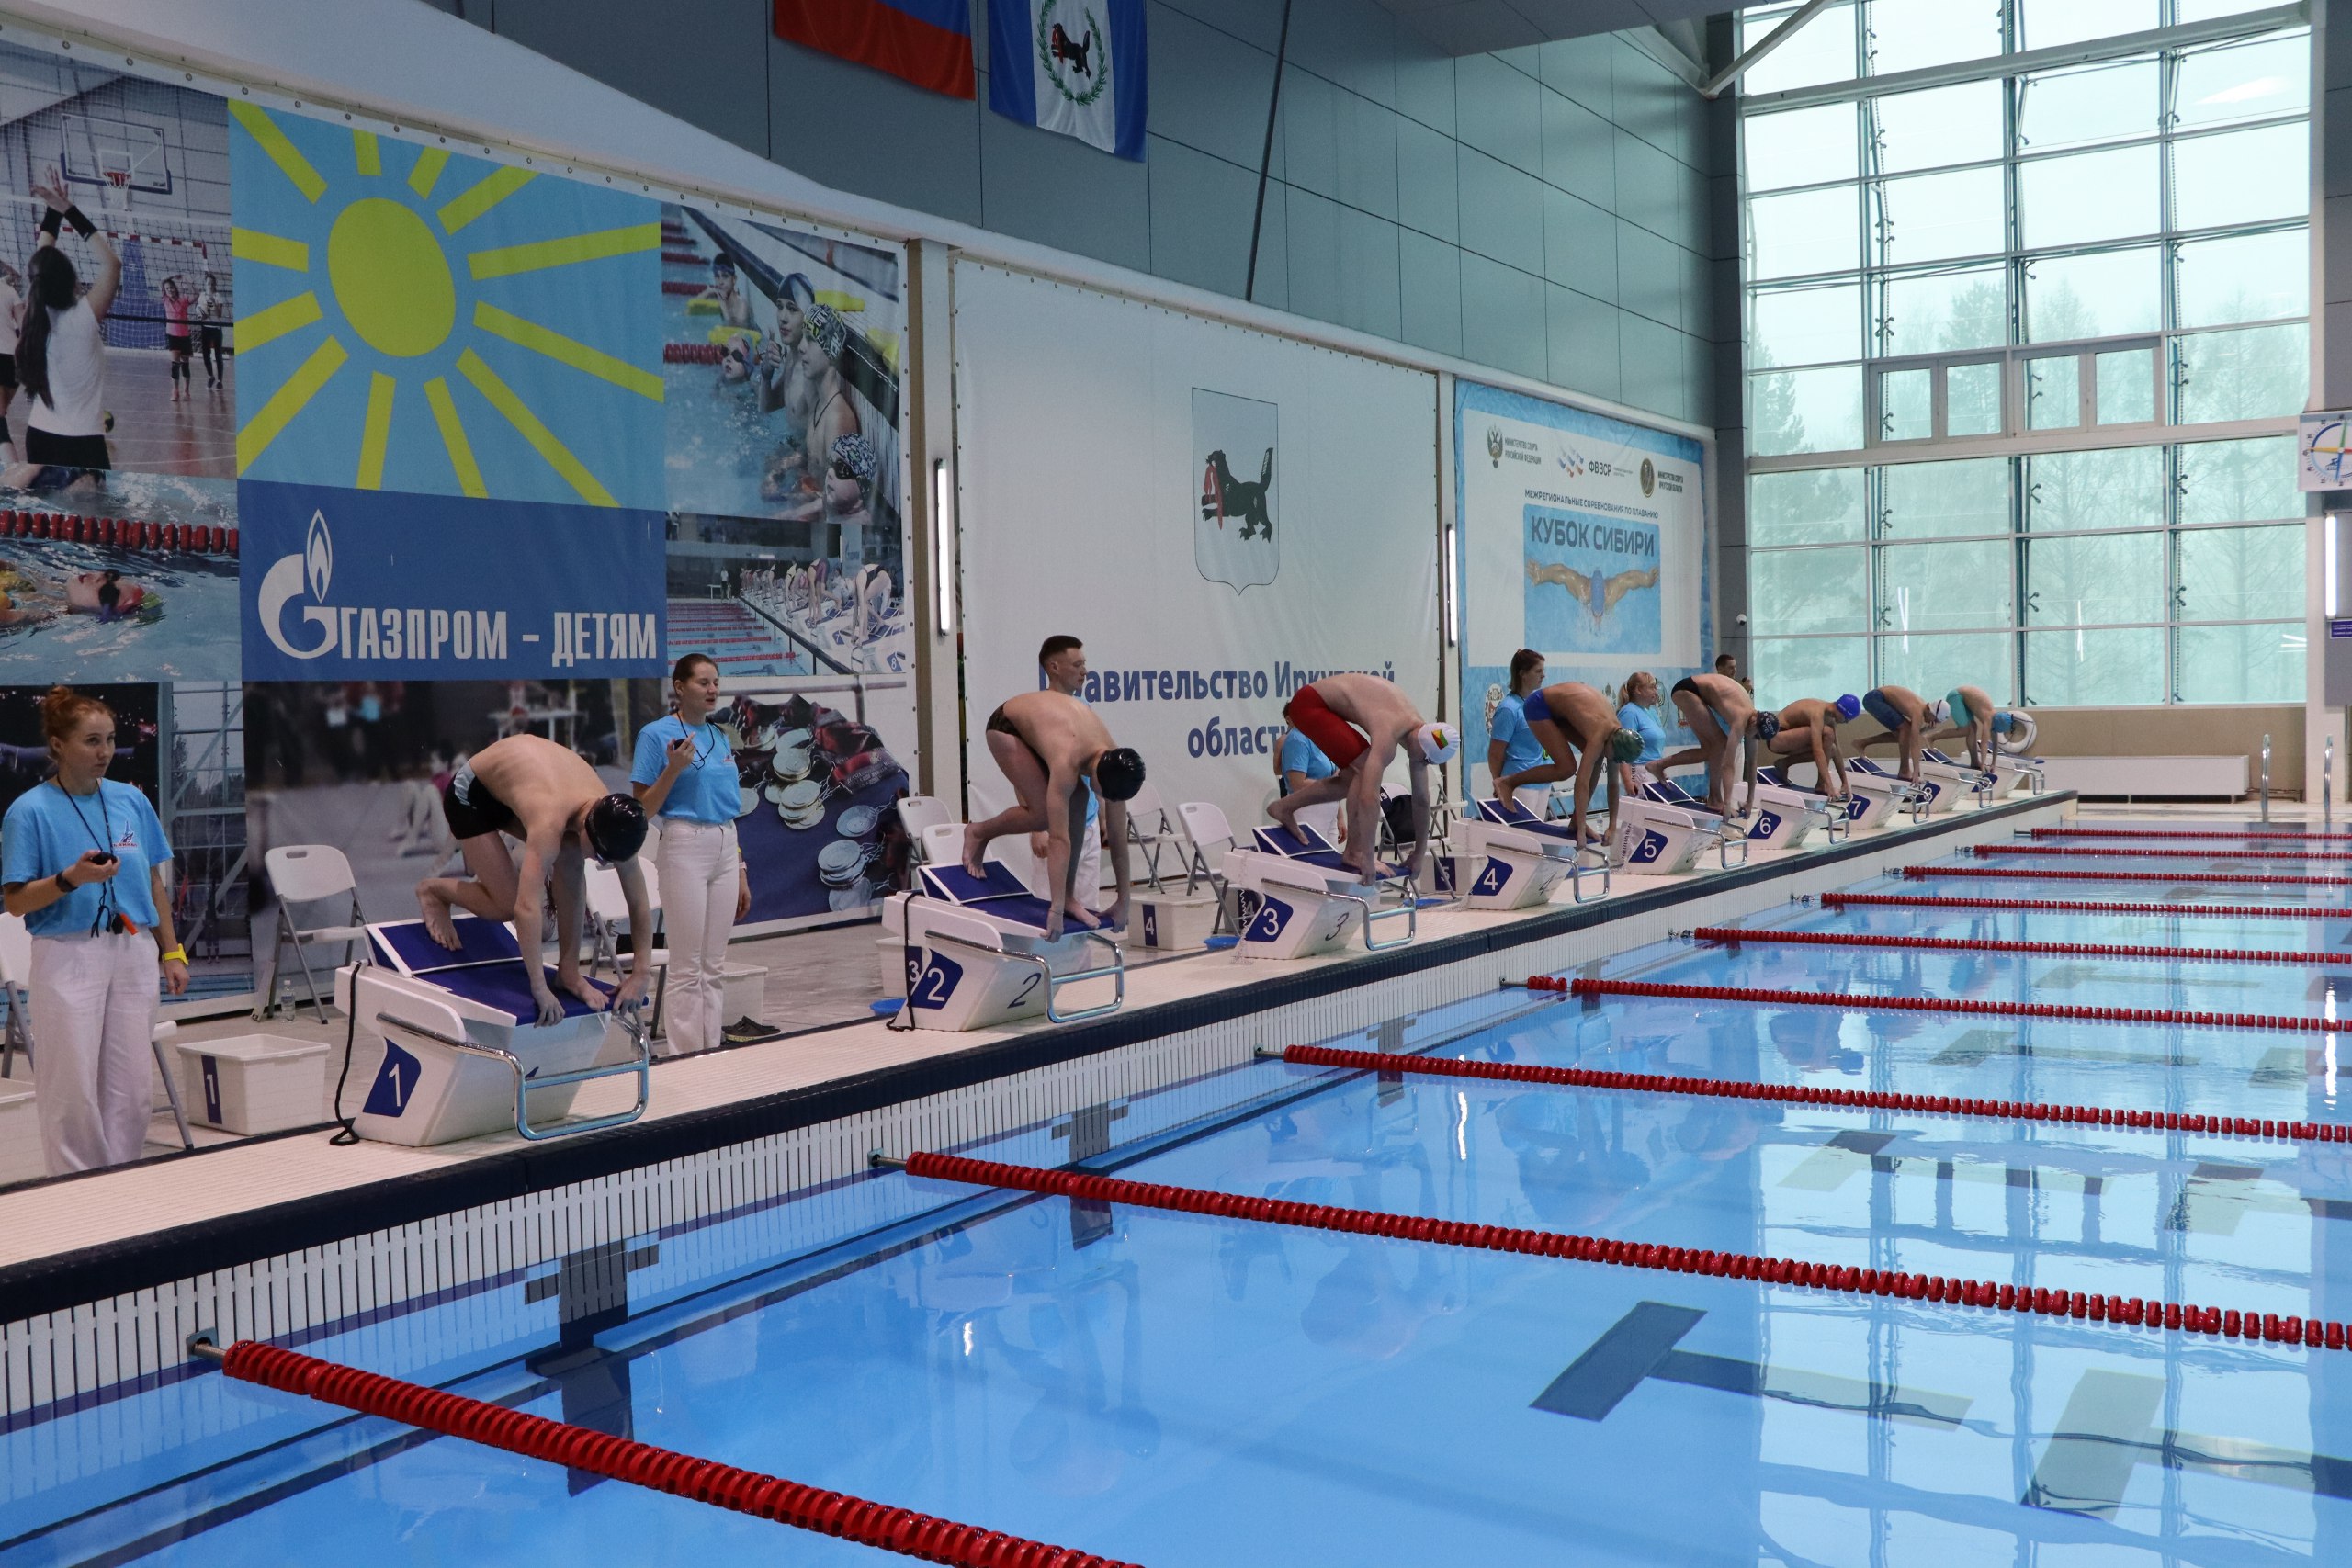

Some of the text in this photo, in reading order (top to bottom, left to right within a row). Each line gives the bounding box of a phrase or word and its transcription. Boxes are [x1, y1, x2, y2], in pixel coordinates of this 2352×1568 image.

[1589, 461, 1611, 477] ФВВСР
[1525, 489, 1659, 519] МЕЖРЕГИОНАЛЬНЫЕ СОРЕВНОВАНИЯ ПО ПЛАВАНИЮ
[1531, 515, 1655, 557] КУБОК СИБИРИ
[341, 607, 507, 660] ГАЗПРОМ
[551, 610, 658, 668] ДЕТЯМ
[890, 658, 898, 671] 8
[1039, 662, 1268, 704] авительство
[1188, 716, 1286, 758] област
[1851, 800, 1861, 816] 7
[1924, 787, 1933, 801] 8
[1759, 818, 1771, 835] 6
[1644, 838, 1657, 859] 5
[1484, 868, 1498, 891] 4
[1145, 917, 1154, 935] 4
[1263, 908, 1280, 936] 3
[1325, 912, 1350, 942] 3
[909, 961, 920, 983] 3
[928, 967, 945, 1002] 2
[1007, 972, 1042, 1009] 2
[206, 1074, 216, 1105] 1
[389, 1063, 401, 1107] 1
